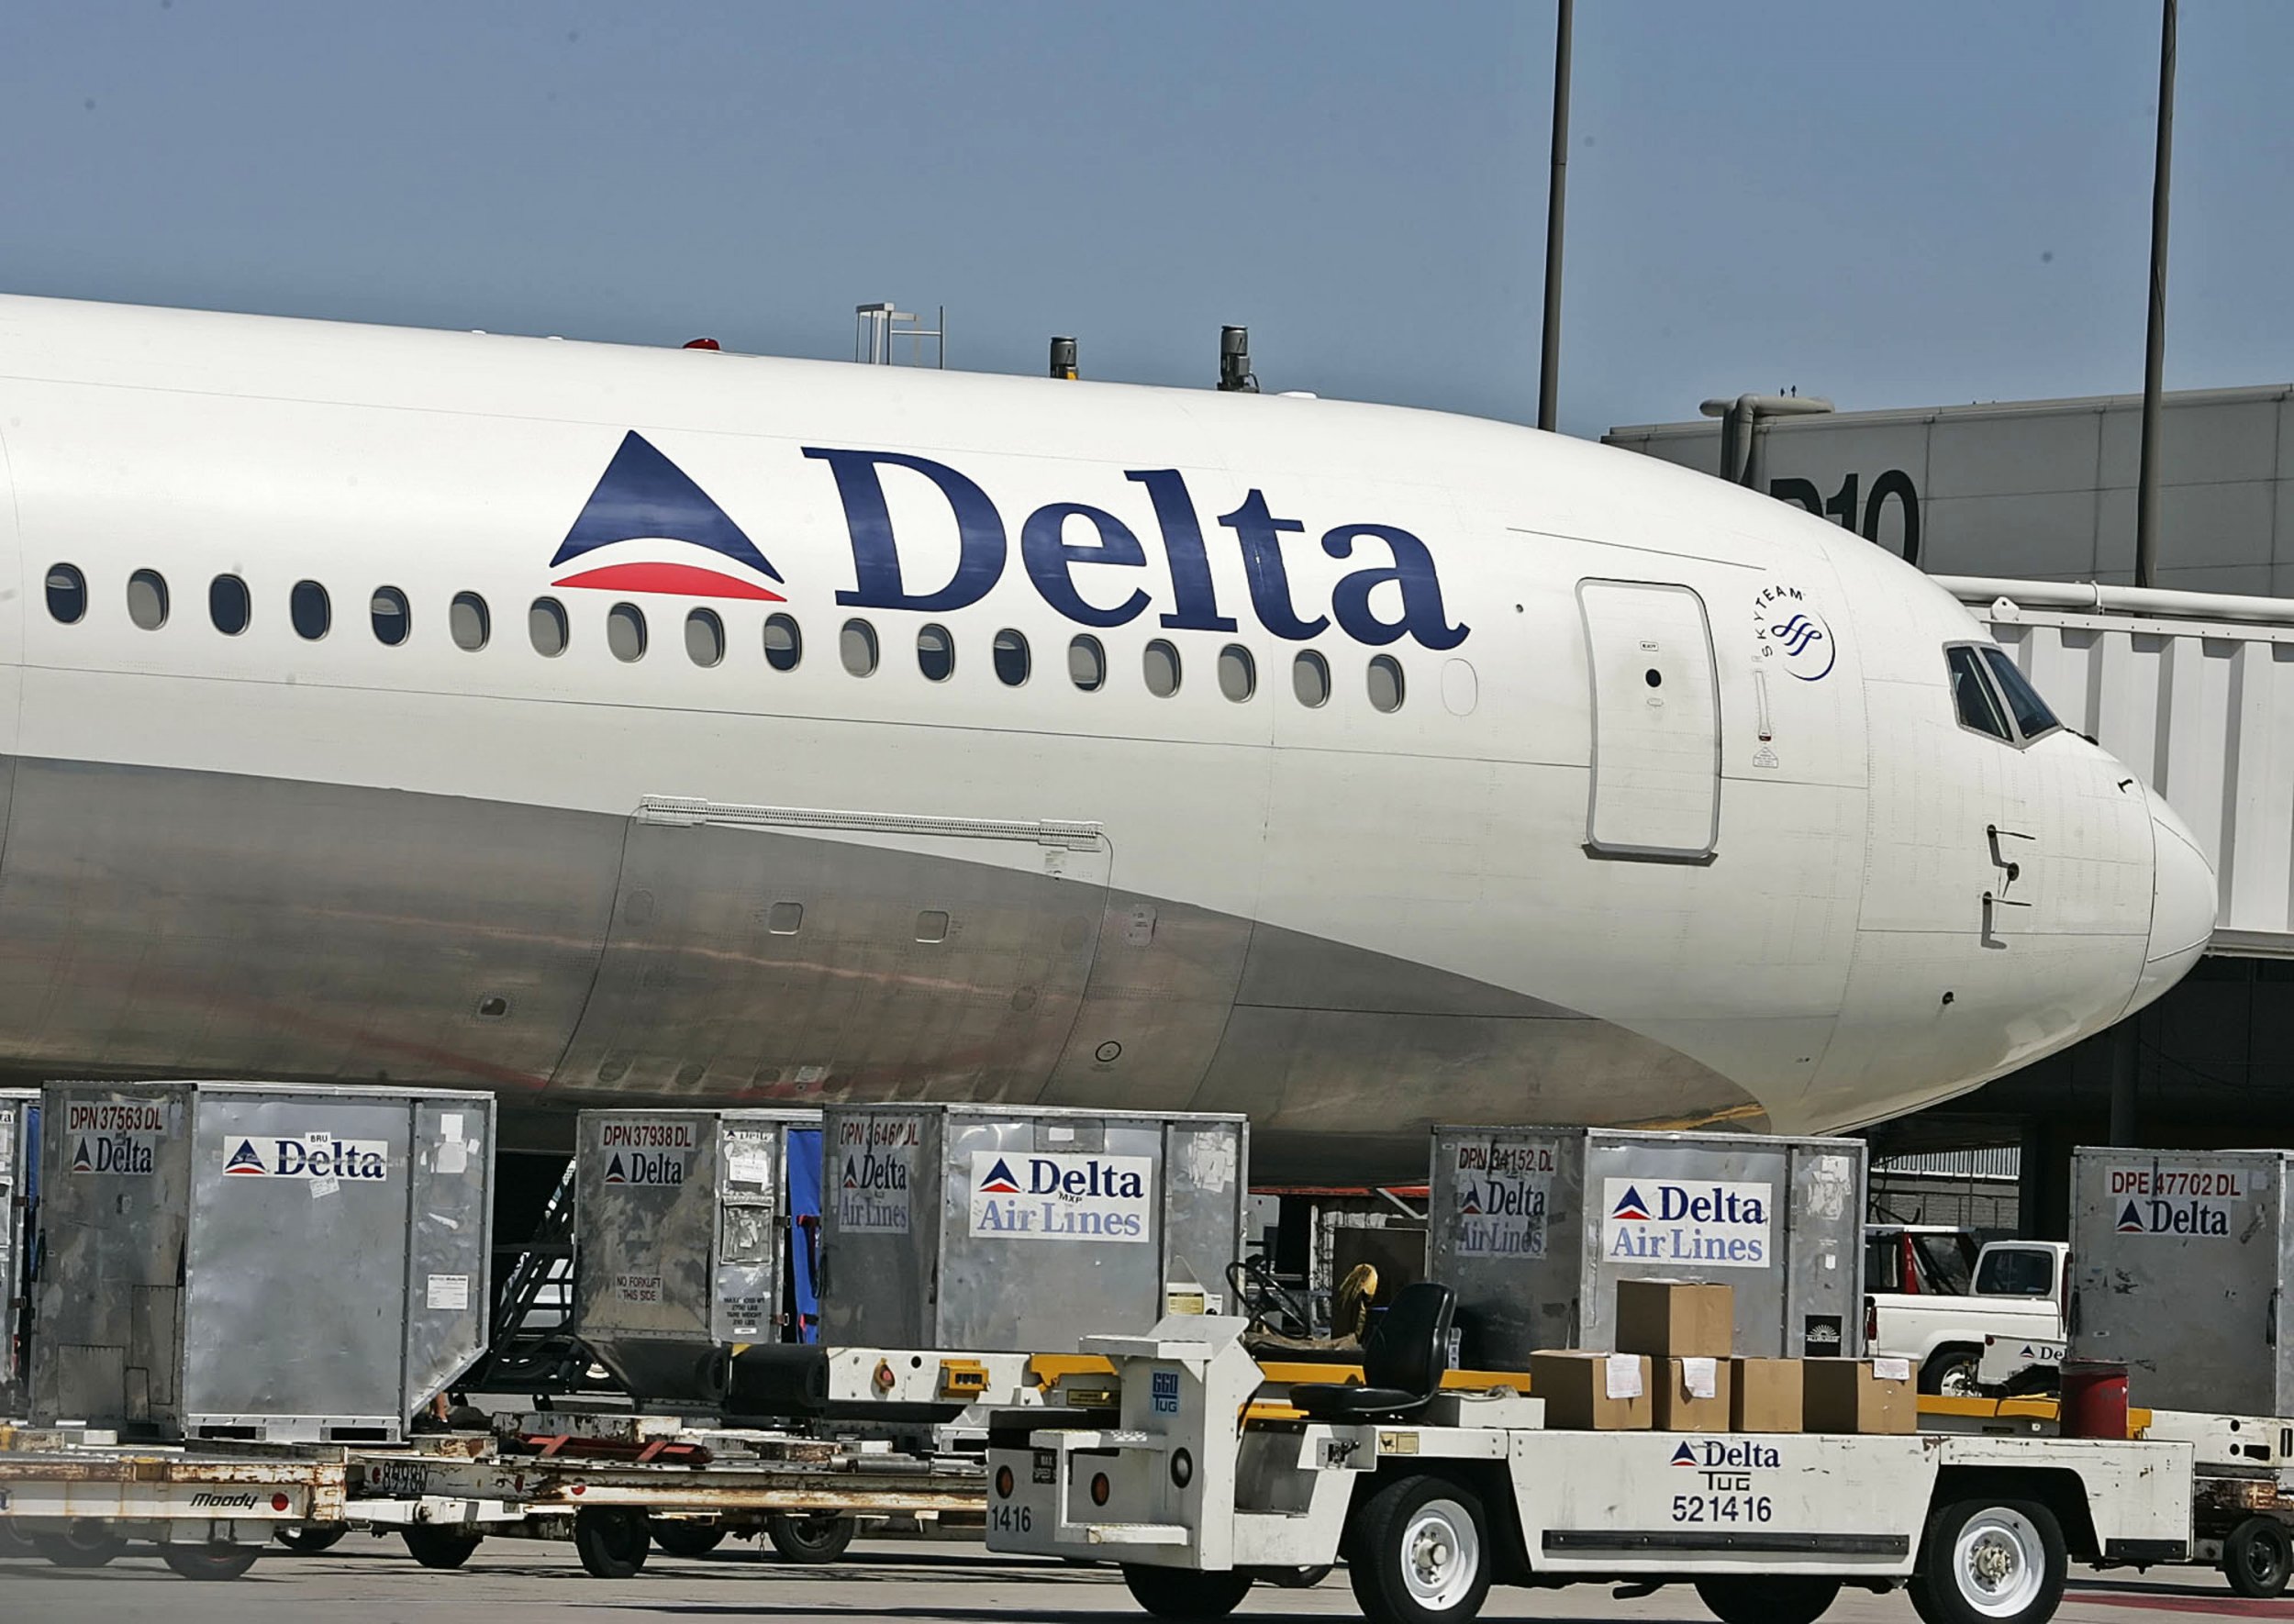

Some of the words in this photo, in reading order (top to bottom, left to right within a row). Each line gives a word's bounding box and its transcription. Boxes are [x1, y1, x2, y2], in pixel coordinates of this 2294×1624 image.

[800, 446, 1470, 651] Delta
[1754, 585, 1803, 658] SKYTEAM
[71, 1106, 98, 1130] DPN
[100, 1106, 142, 1130] 37563
[145, 1106, 162, 1130] DL
[310, 1134, 328, 1143] BRU
[603, 1126, 632, 1146] DPN
[635, 1126, 672, 1147] 37938
[674, 1128, 691, 1147] DL
[95, 1137, 152, 1174] Delta
[275, 1140, 385, 1178] Delta
[631, 1152, 683, 1185] Delta
[860, 1153, 907, 1190] Delta
[1459, 1147, 1487, 1170] DPN
[1538, 1150, 1553, 1172] DL
[1028, 1159, 1144, 1199] Delta
[2112, 1172, 2150, 1194] DPE
[2155, 1173, 2212, 1196] 47702
[2216, 1174, 2241, 1196] DL
[841, 1196, 863, 1227] Air
[865, 1196, 907, 1229] Lines
[1485, 1180, 1544, 1216] Delta
[1658, 1186, 1767, 1224] Delta
[977, 1200, 1037, 1231] Air
[1041, 1201, 1141, 1236] Lines
[2150, 1199, 2228, 1235] Delta
[1459, 1221, 1486, 1251] Air
[1490, 1222, 1542, 1253] Lines
[1610, 1227, 1666, 1259] Air
[1670, 1228, 1763, 1262] Lines
[617, 1276, 628, 1286] NO
[640, 1290, 656, 1301] SIDE
[1703, 1440, 1781, 1468] Delta
[189, 1493, 258, 1510] Moody
[1672, 1496, 1772, 1522] 521416
[992, 1505, 1031, 1532] 1416
